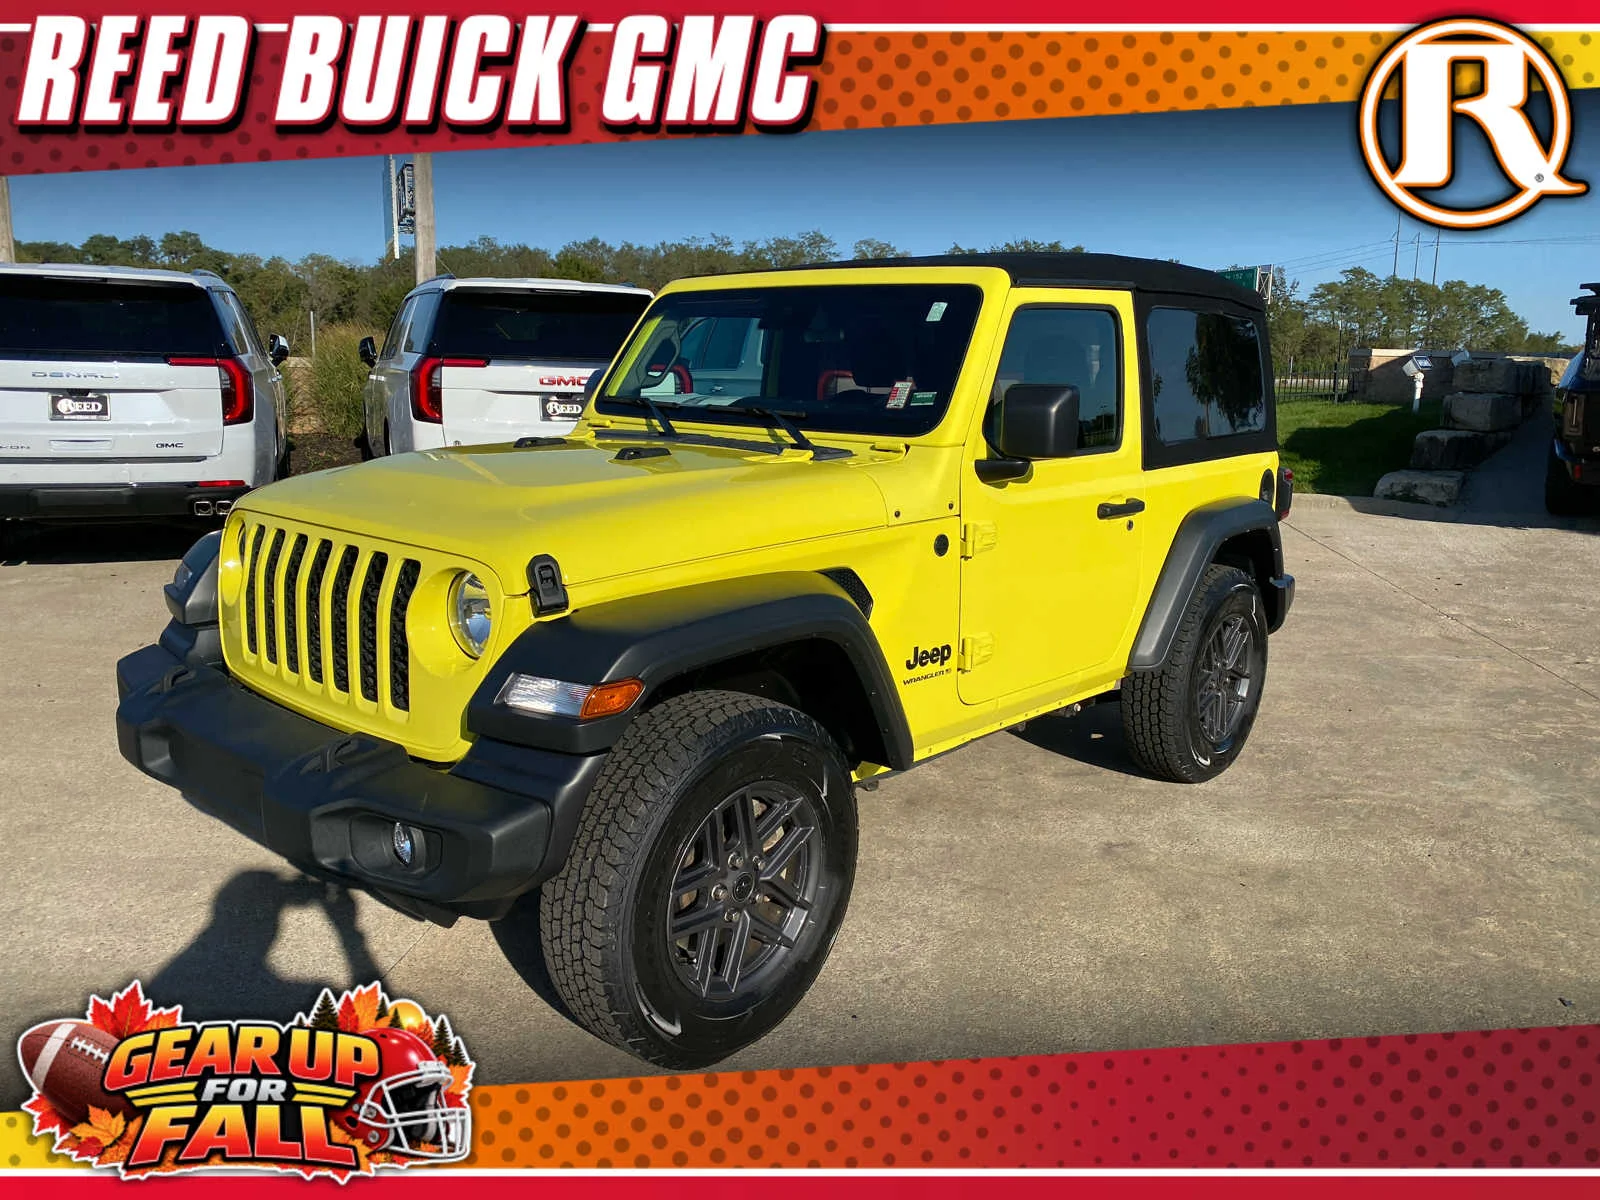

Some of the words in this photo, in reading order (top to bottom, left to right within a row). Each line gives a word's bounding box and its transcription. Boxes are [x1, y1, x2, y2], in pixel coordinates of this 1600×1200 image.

[31, 371, 119, 379] DENALI
[539, 375, 590, 386] GMC
[155, 441, 184, 449] GMC
[904, 643, 952, 671] Jeep
[902, 669, 945, 686] WRANGLER
